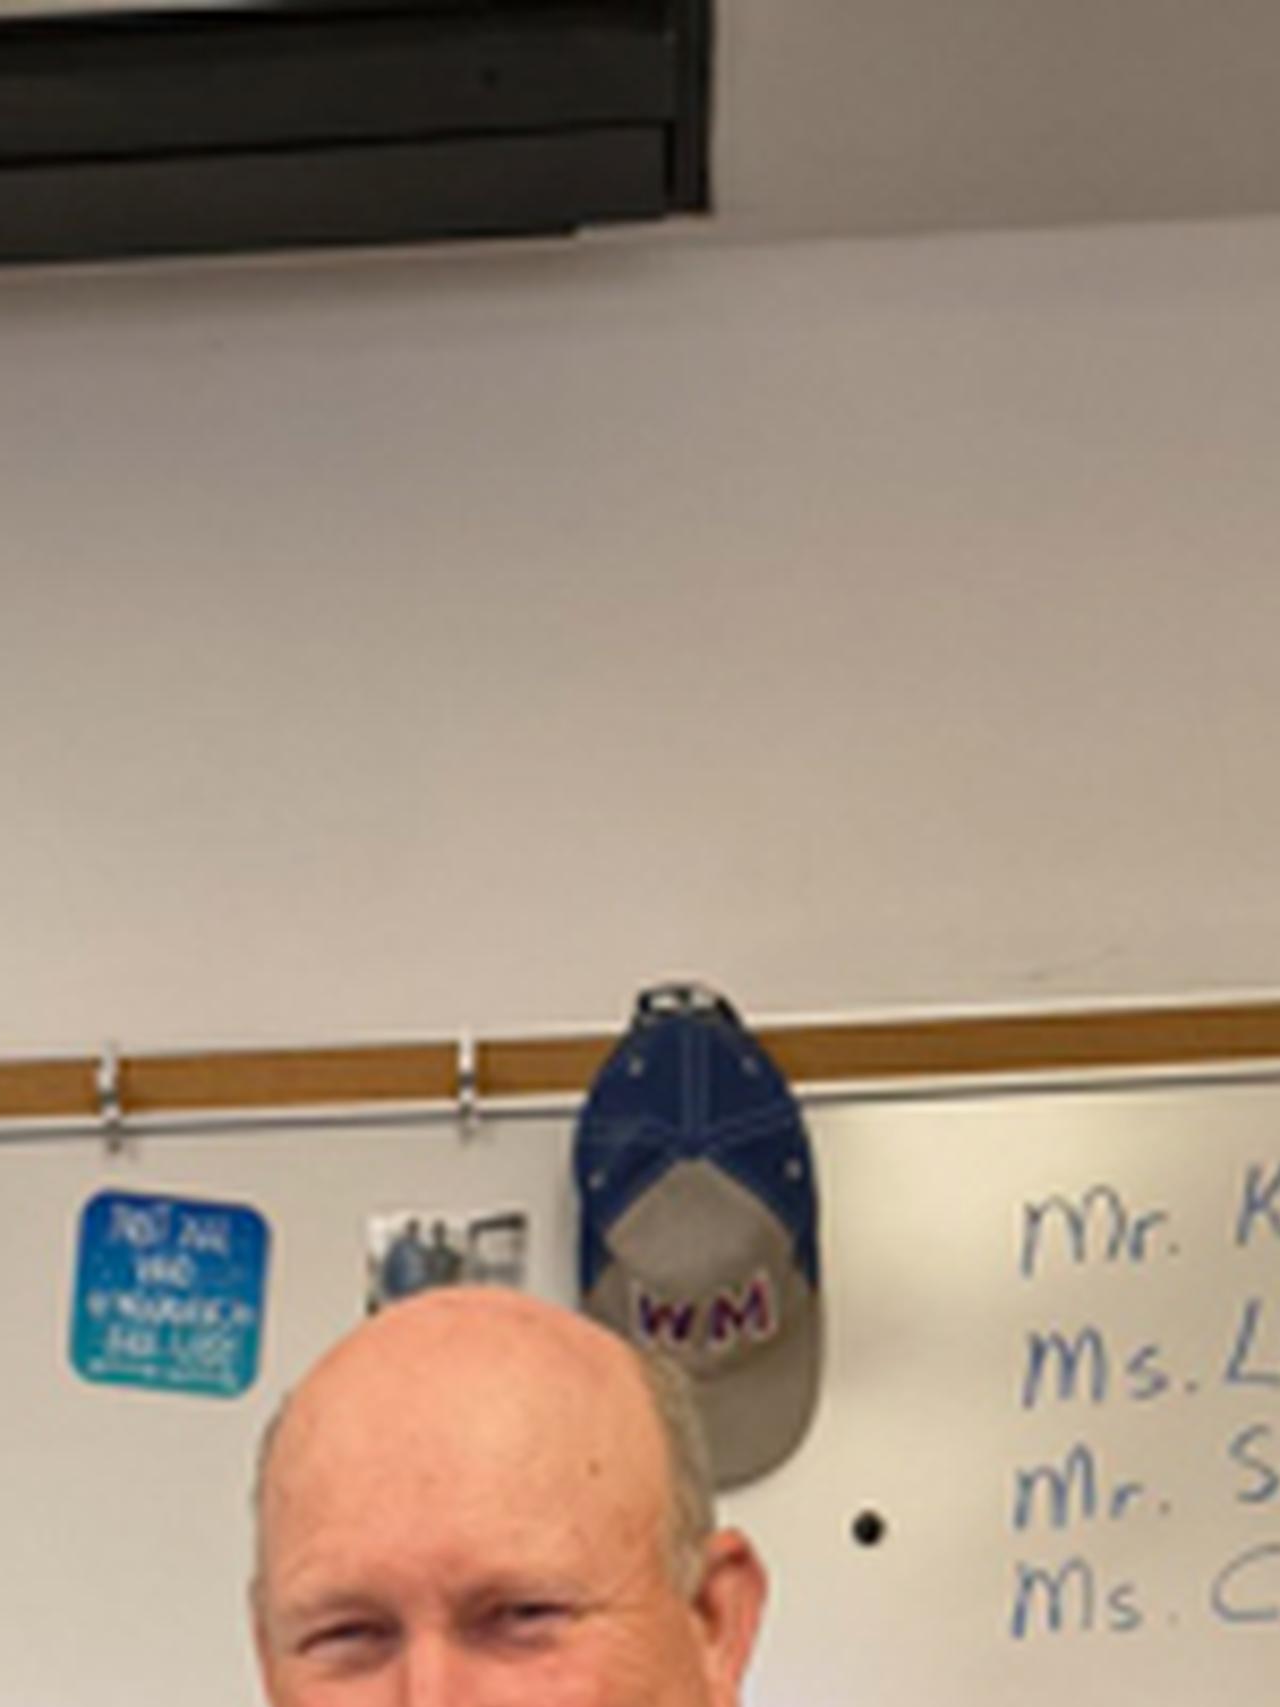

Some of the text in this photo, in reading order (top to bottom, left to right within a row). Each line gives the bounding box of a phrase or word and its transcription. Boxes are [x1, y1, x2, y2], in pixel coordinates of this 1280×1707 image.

[1022, 1183, 1180, 1279] Mr.
[1022, 1325, 1199, 1410] Ms.
[1014, 1443, 1172, 1531] Mr.
[1011, 1557, 1180, 1640] Ms.
